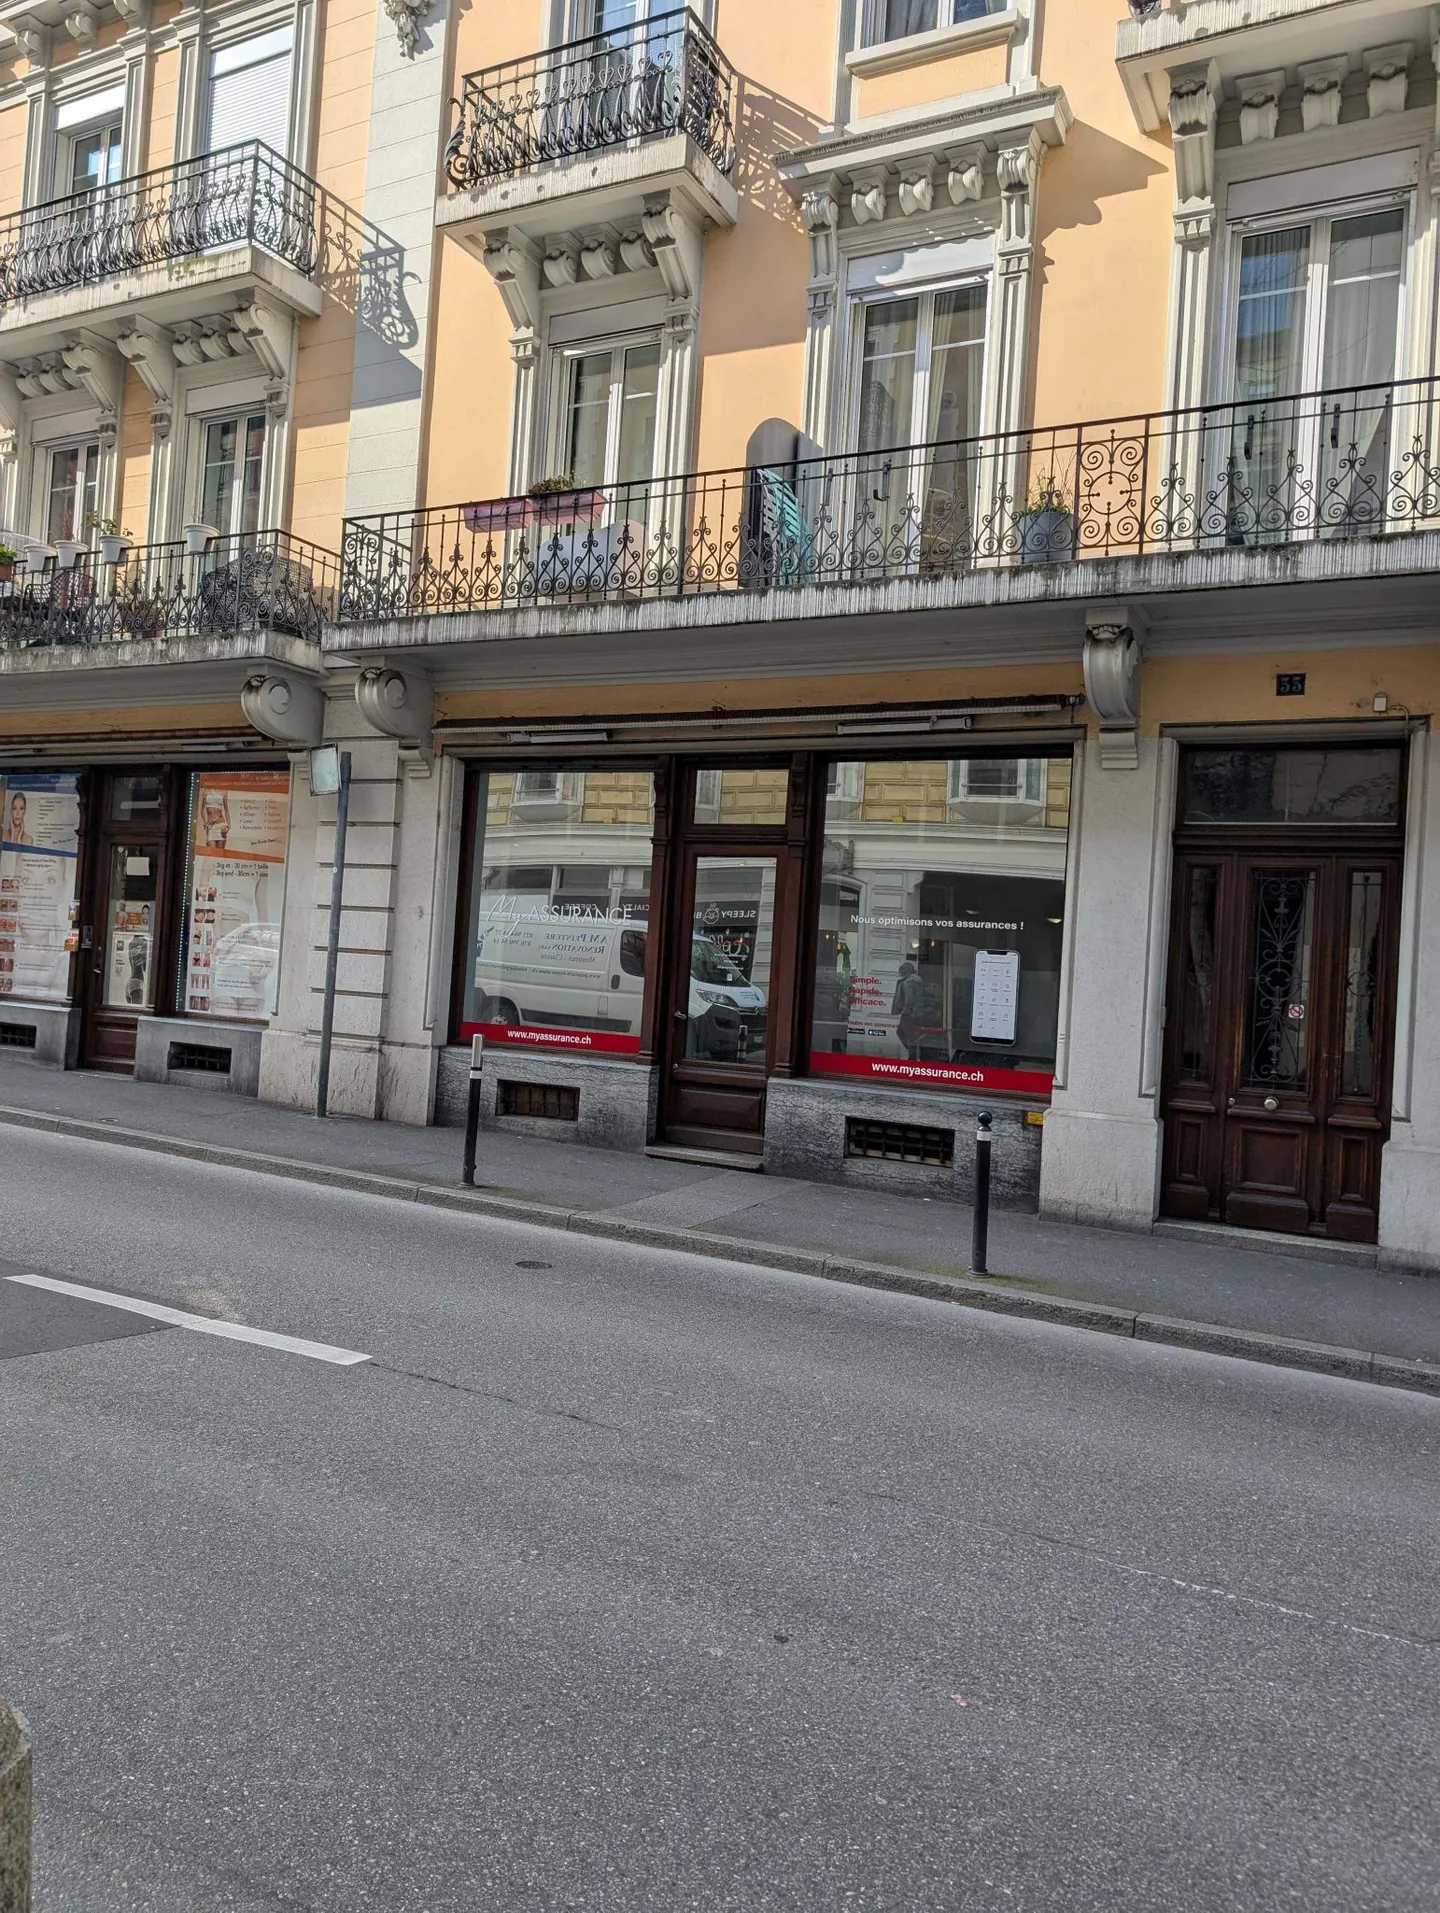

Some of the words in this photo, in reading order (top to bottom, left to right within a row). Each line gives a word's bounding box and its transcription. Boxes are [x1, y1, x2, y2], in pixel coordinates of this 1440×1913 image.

[486, 894, 527, 938] My
[528, 904, 632, 926] ASSURANCE
[850, 914, 876, 924] Nous
[878, 916, 933, 926] optimisons
[936, 919, 954, 928] vos
[956, 920, 1018, 930] assurances
[1020, 921, 1024, 930] !
[849, 975, 882, 985] Simple.
[848, 985, 882, 996] Rapide.
[848, 995, 886, 1006] Efficace.
[507, 1029, 592, 1045] www.myassurance.ch
[871, 1062, 984, 1082] www.myassurance.ch
